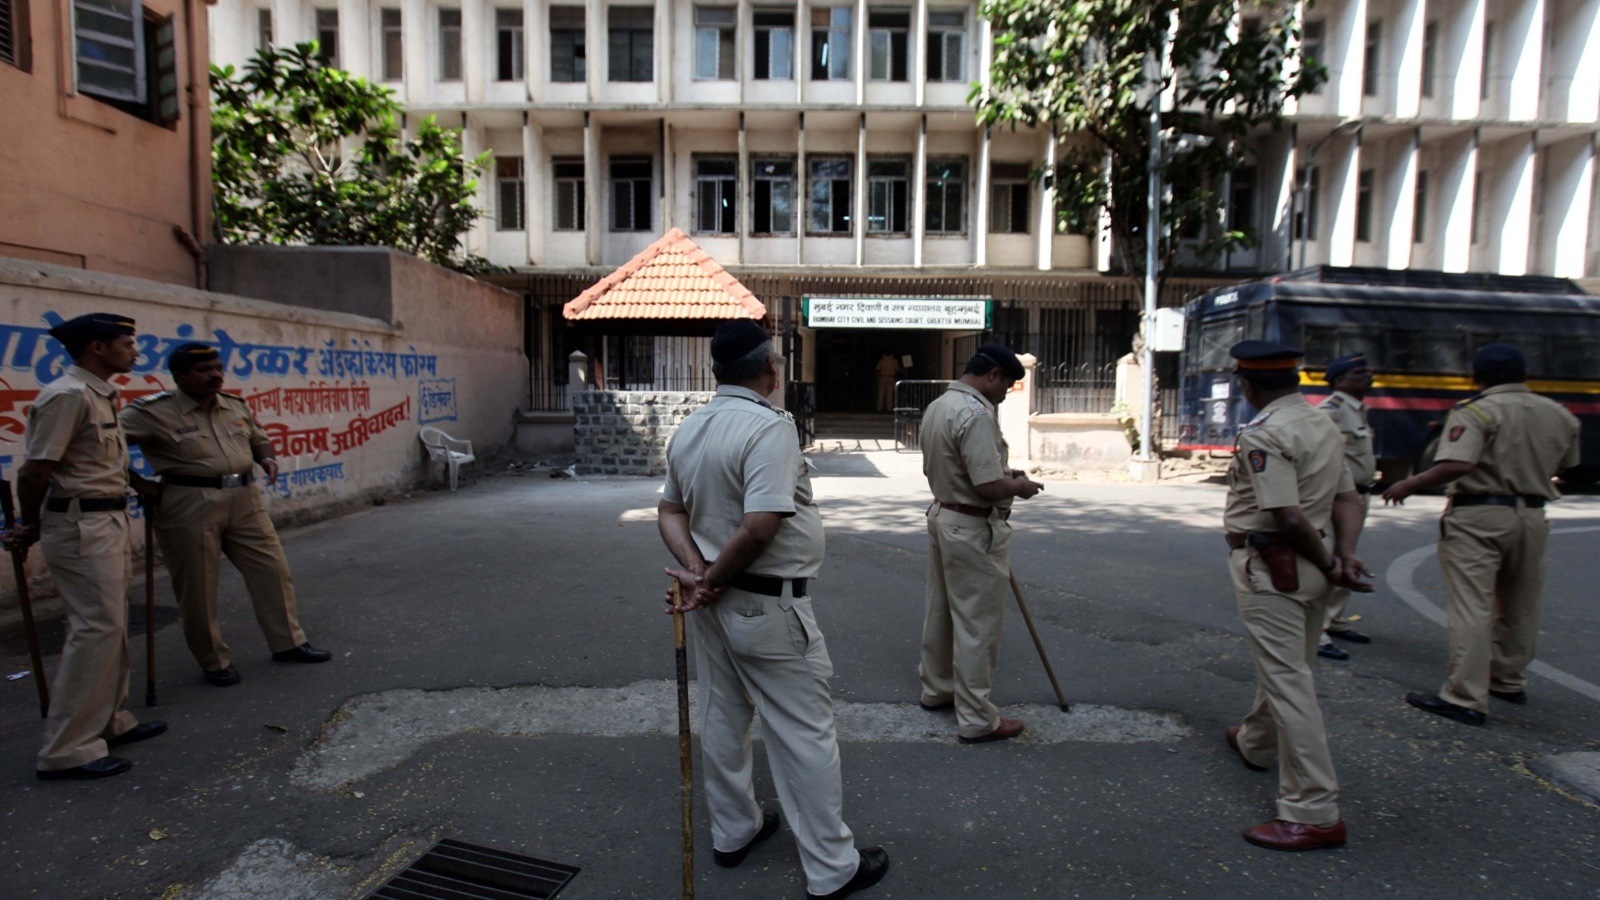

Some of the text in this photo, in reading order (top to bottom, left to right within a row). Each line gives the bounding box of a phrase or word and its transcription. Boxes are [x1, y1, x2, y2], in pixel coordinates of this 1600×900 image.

[813, 315, 835, 323] BOMBAY
[837, 315, 850, 323] CITY
[851, 315, 865, 323] CIVIL
[866, 316, 877, 324] AND
[878, 316, 904, 324] SESSIONS
[926, 317, 952, 325] GREATER
[954, 317, 981, 325] MUMBAI
